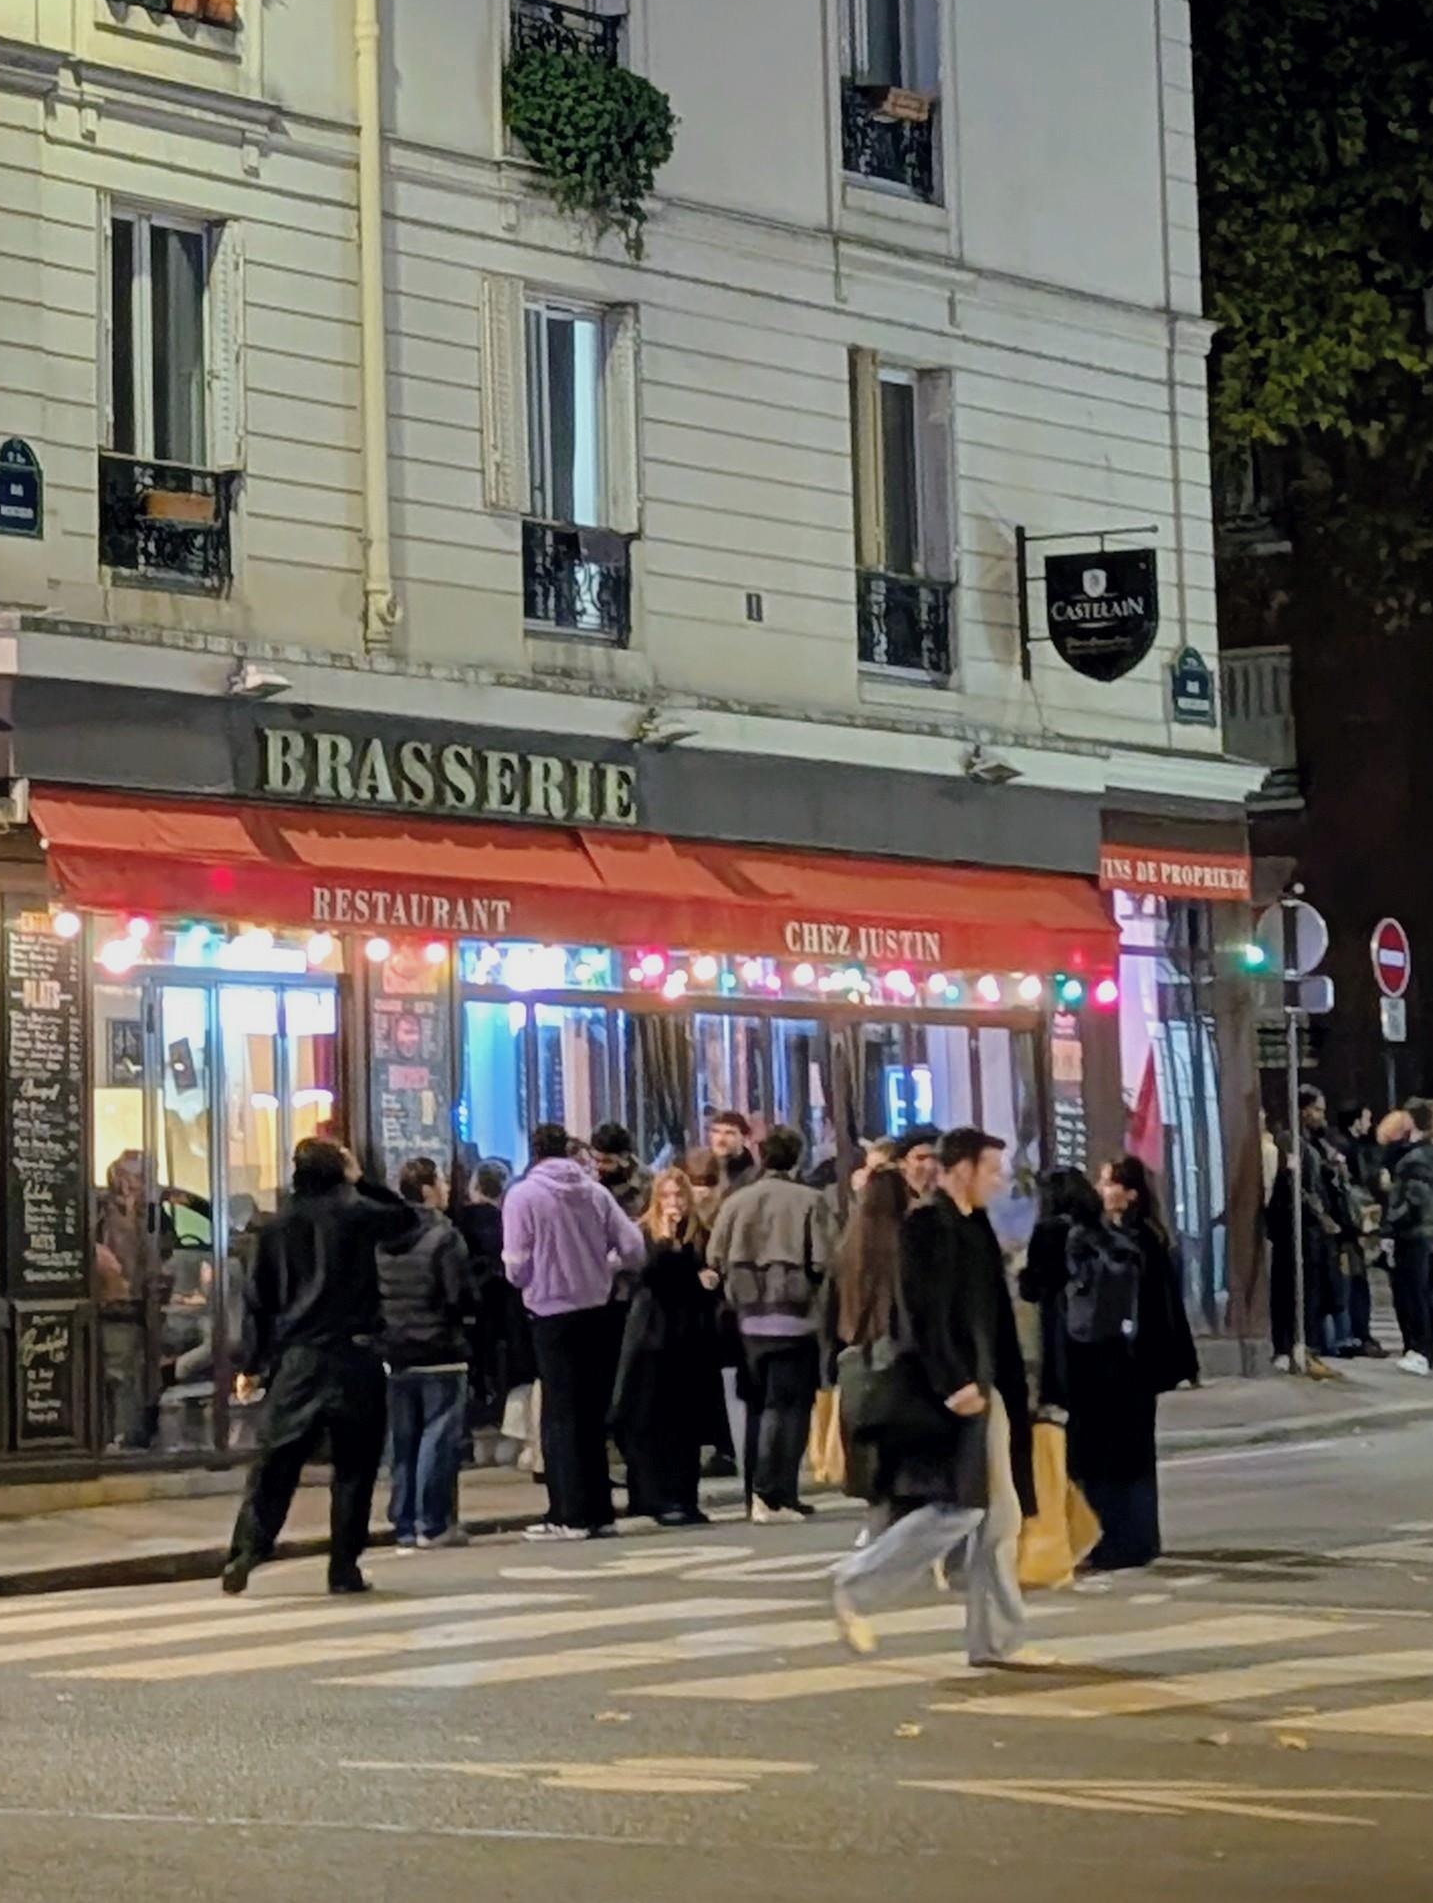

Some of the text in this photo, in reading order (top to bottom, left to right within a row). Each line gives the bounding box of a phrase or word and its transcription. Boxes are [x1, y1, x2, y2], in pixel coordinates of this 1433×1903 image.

[1051, 597, 1144, 621] CASTELAIN
[263, 728, 638, 825] BRASSERIE
[1136, 861, 1158, 882] DE
[312, 886, 511, 932] RESTAURANT
[785, 921, 941, 962] CHEZ JUSTIN
